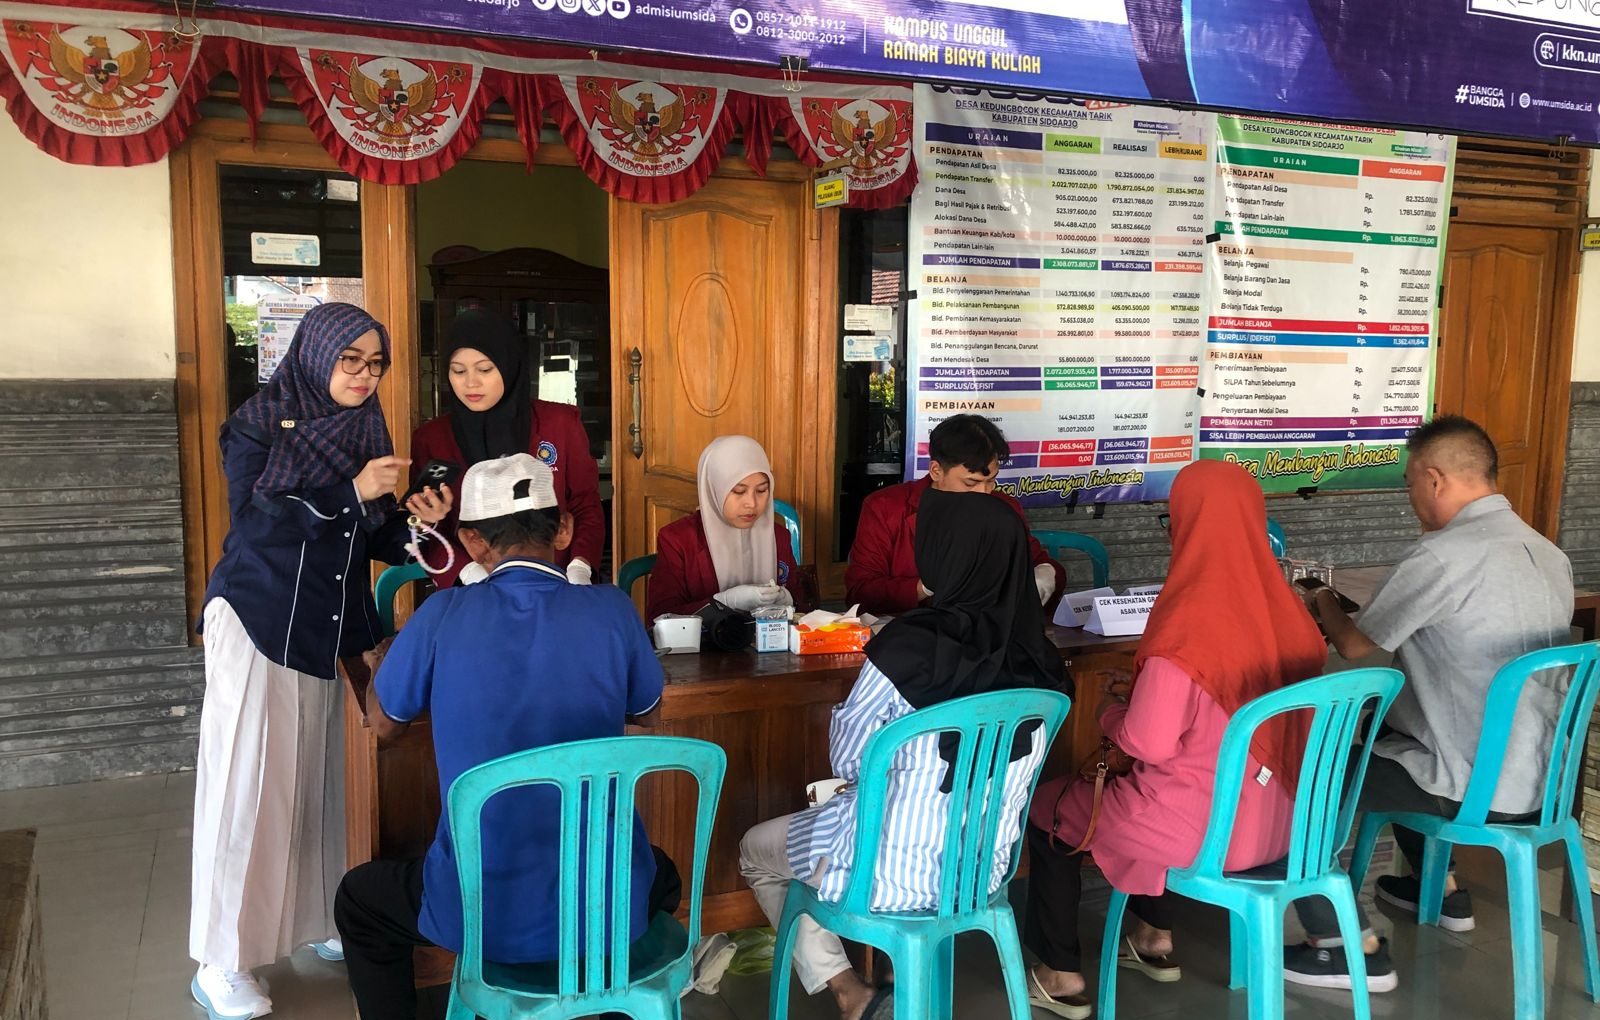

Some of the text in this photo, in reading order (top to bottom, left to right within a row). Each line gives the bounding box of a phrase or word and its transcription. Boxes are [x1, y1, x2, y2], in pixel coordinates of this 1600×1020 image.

[635, 4, 717, 23] admisiumsida
[756, 10, 846, 31] 0857-1011-1912
[756, 26, 846, 45] 0812-3000-2012
[884, 16, 1009, 48] KAMPUS UNGGUL
[884, 40, 1042, 75] RAMAH BIAYA KULIAH
[1470, 84, 1504, 98] BANGGA
[1469, 95, 1506, 109] UMSIDA
[1532, 99, 1592, 112] www.umsida.ac.id
[956, 100, 1112, 120] DESA KEDUNGBOCOK KECAMATAN TARIK
[51, 102, 158, 135] INDONESIA
[992, 114, 1078, 128] KABUPATEN SIDOARJO
[1244, 124, 1260, 132] DESA
[1262, 127, 1312, 138] KEDUNGBOCOK
[1314, 132, 1353, 142] KECAMATAN
[350, 130, 442, 160] INDONESIA
[968, 133, 1009, 142] URAIAN
[1054, 140, 1093, 150] ANGGARAN
[1113, 144, 1148, 152] REALISASI
[1272, 137, 1344, 150] KABUPATEN SIDOARJO
[930, 146, 982, 158] PENDAPATAN
[608, 151, 688, 176] INDONESIA
[936, 159, 970, 168] Pendapatan
[1058, 168, 1097, 176] 82.325.000,00
[1274, 156, 1422, 176] URAIAN ANGGARAN
[848, 168, 902, 190] DONESIA
[936, 172, 970, 183] Pendapatan
[970, 176, 994, 184] Transfer
[935, 200, 950, 208] Bagi
[962, 229, 988, 238] Keuangan
[1251, 227, 1288, 235] PENDAPATAN
[934, 242, 970, 250] Pendapatan
[938, 256, 1010, 266] JUMLAH PENDAPATAN
[1224, 260, 1270, 269] Belanja Pegawai
[1224, 274, 1243, 282] Belanja
[1244, 276, 1266, 284] Barang
[946, 288, 994, 296] Penyelenggaraan
[1223, 288, 1242, 297] Belanja
[1260, 304, 1282, 313] Terduga
[945, 329, 988, 337] Pemberdayaan
[944, 342, 992, 350] Penanggulangan
[1210, 352, 1263, 360] PEMBIAYAAN
[1212, 392, 1253, 400] Pengeluaran
[1221, 407, 1258, 415] Penyertaan
[1262, 443, 1400, 482] Membangun Indonesia
[1018, 468, 1144, 499] Membangun Indonesia
[1113, 597, 1147, 605] KESEHATAN
